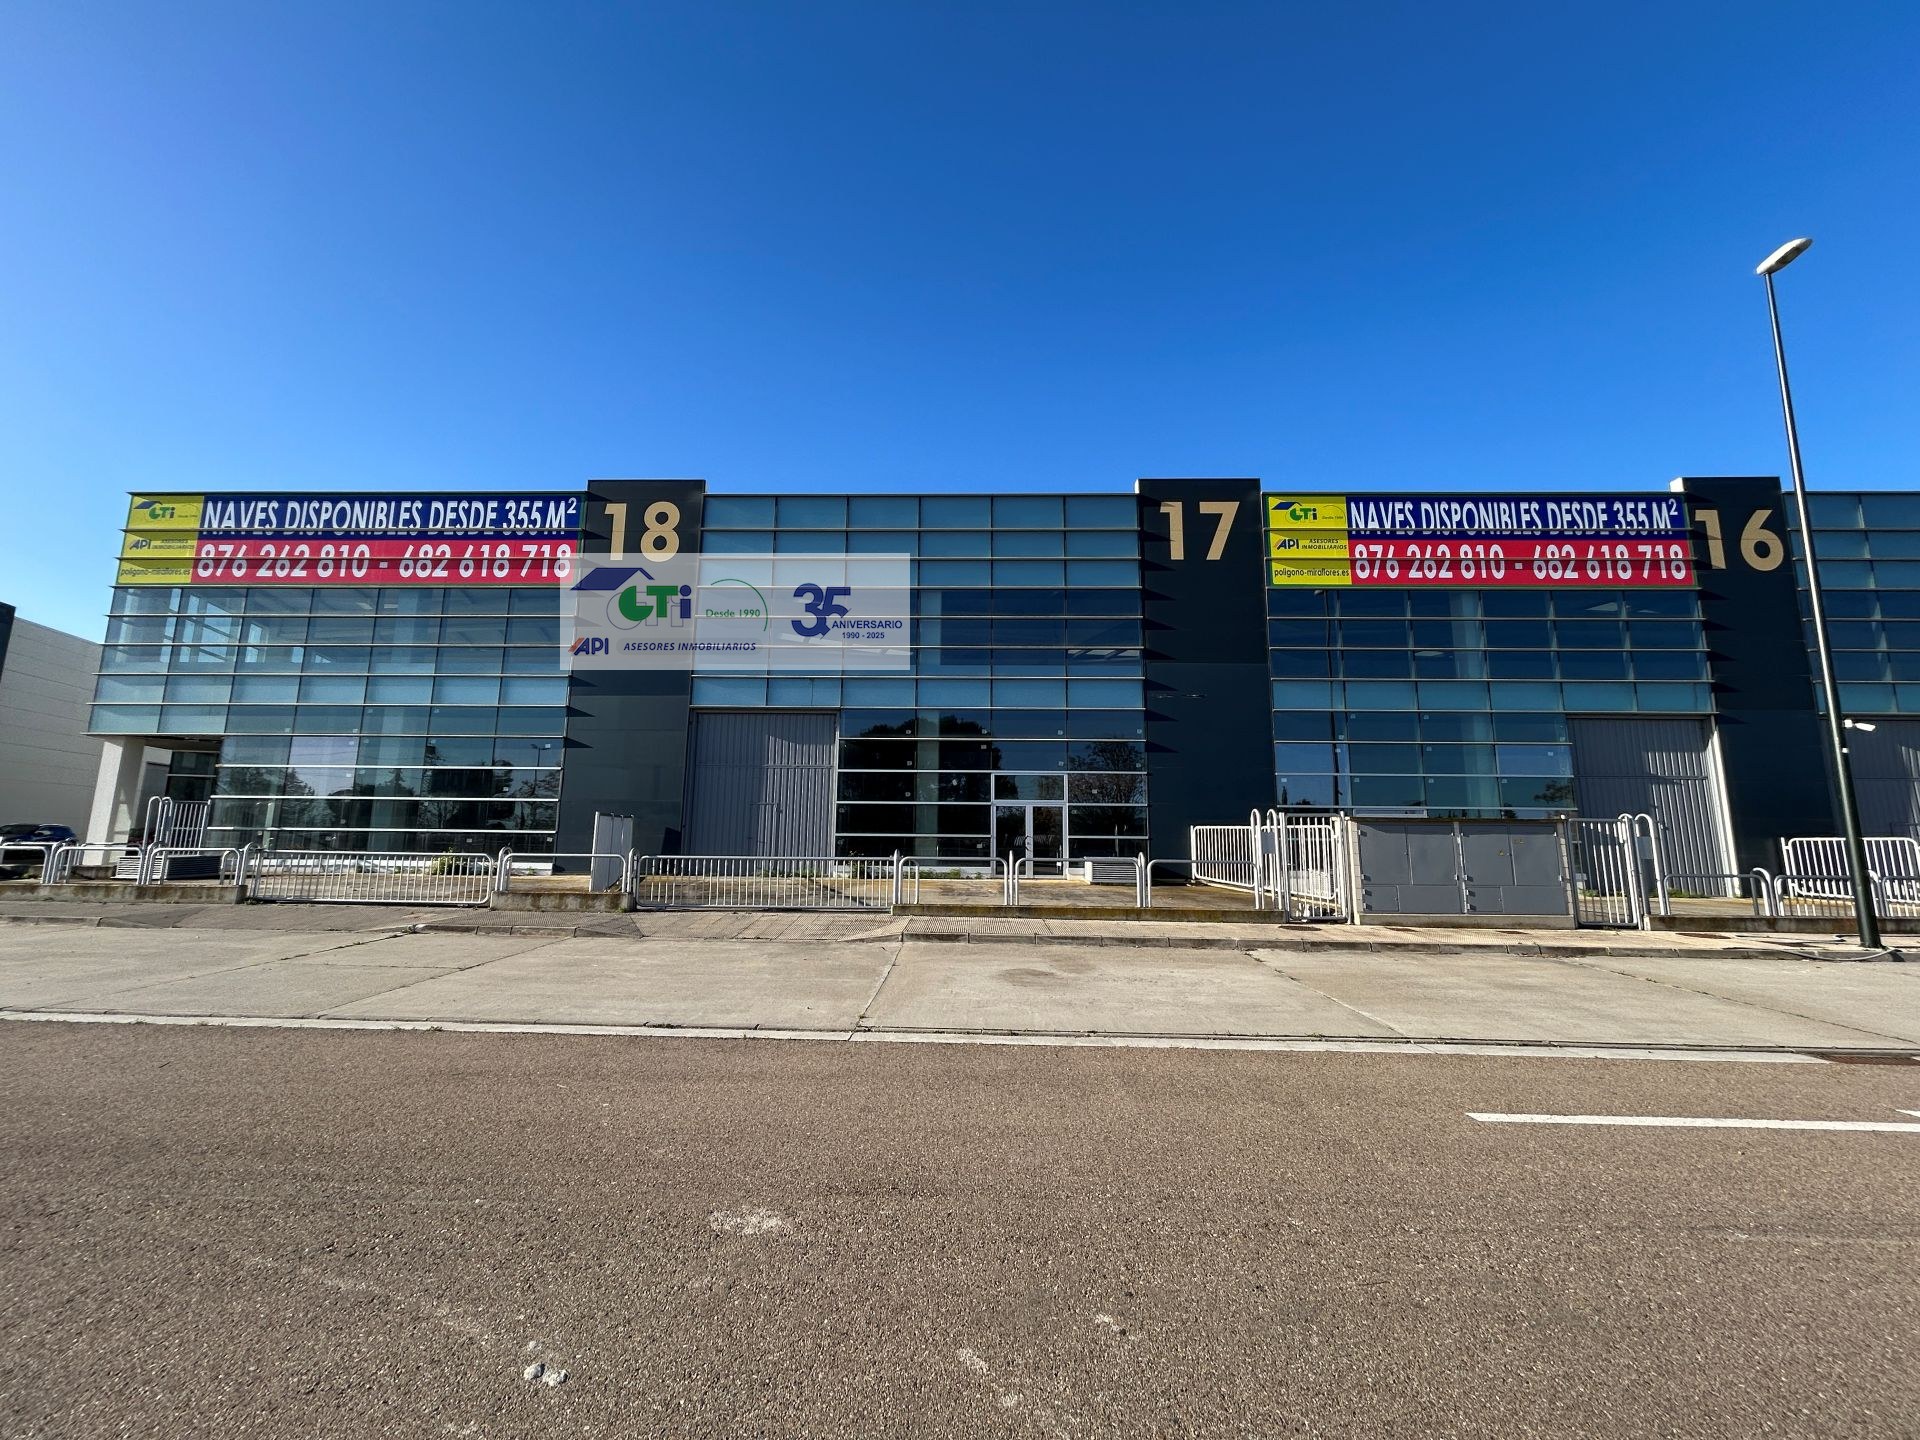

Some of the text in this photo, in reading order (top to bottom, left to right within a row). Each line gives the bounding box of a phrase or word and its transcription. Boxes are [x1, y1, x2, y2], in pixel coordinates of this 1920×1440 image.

[203, 500, 279, 535] NAVES
[284, 500, 423, 535] DISPONIBLES
[427, 500, 498, 535] DESDE
[502, 500, 542, 535] 355
[604, 501, 681, 562] 18
[1159, 501, 1240, 561] 17
[1350, 501, 1415, 535] NAVES
[1421, 501, 1543, 536] DISPONIBLES
[1546, 501, 1608, 535] DESDE
[1612, 501, 1650, 535] 355
[1276, 538, 1300, 551] API
[1693, 509, 1784, 571] 16
[197, 544, 248, 578] 876
[256, 544, 310, 578] 262
[316, 544, 371, 578] 810
[398, 544, 451, 578] 682
[458, 544, 511, 578] 618
[519, 544, 572, 578] 718
[1354, 544, 1400, 579] 876
[1407, 544, 1454, 579] 262
[1459, 544, 1506, 579] 810
[1533, 544, 1579, 579] 682
[1586, 544, 1632, 579] 618
[1637, 544, 1687, 579] 718
